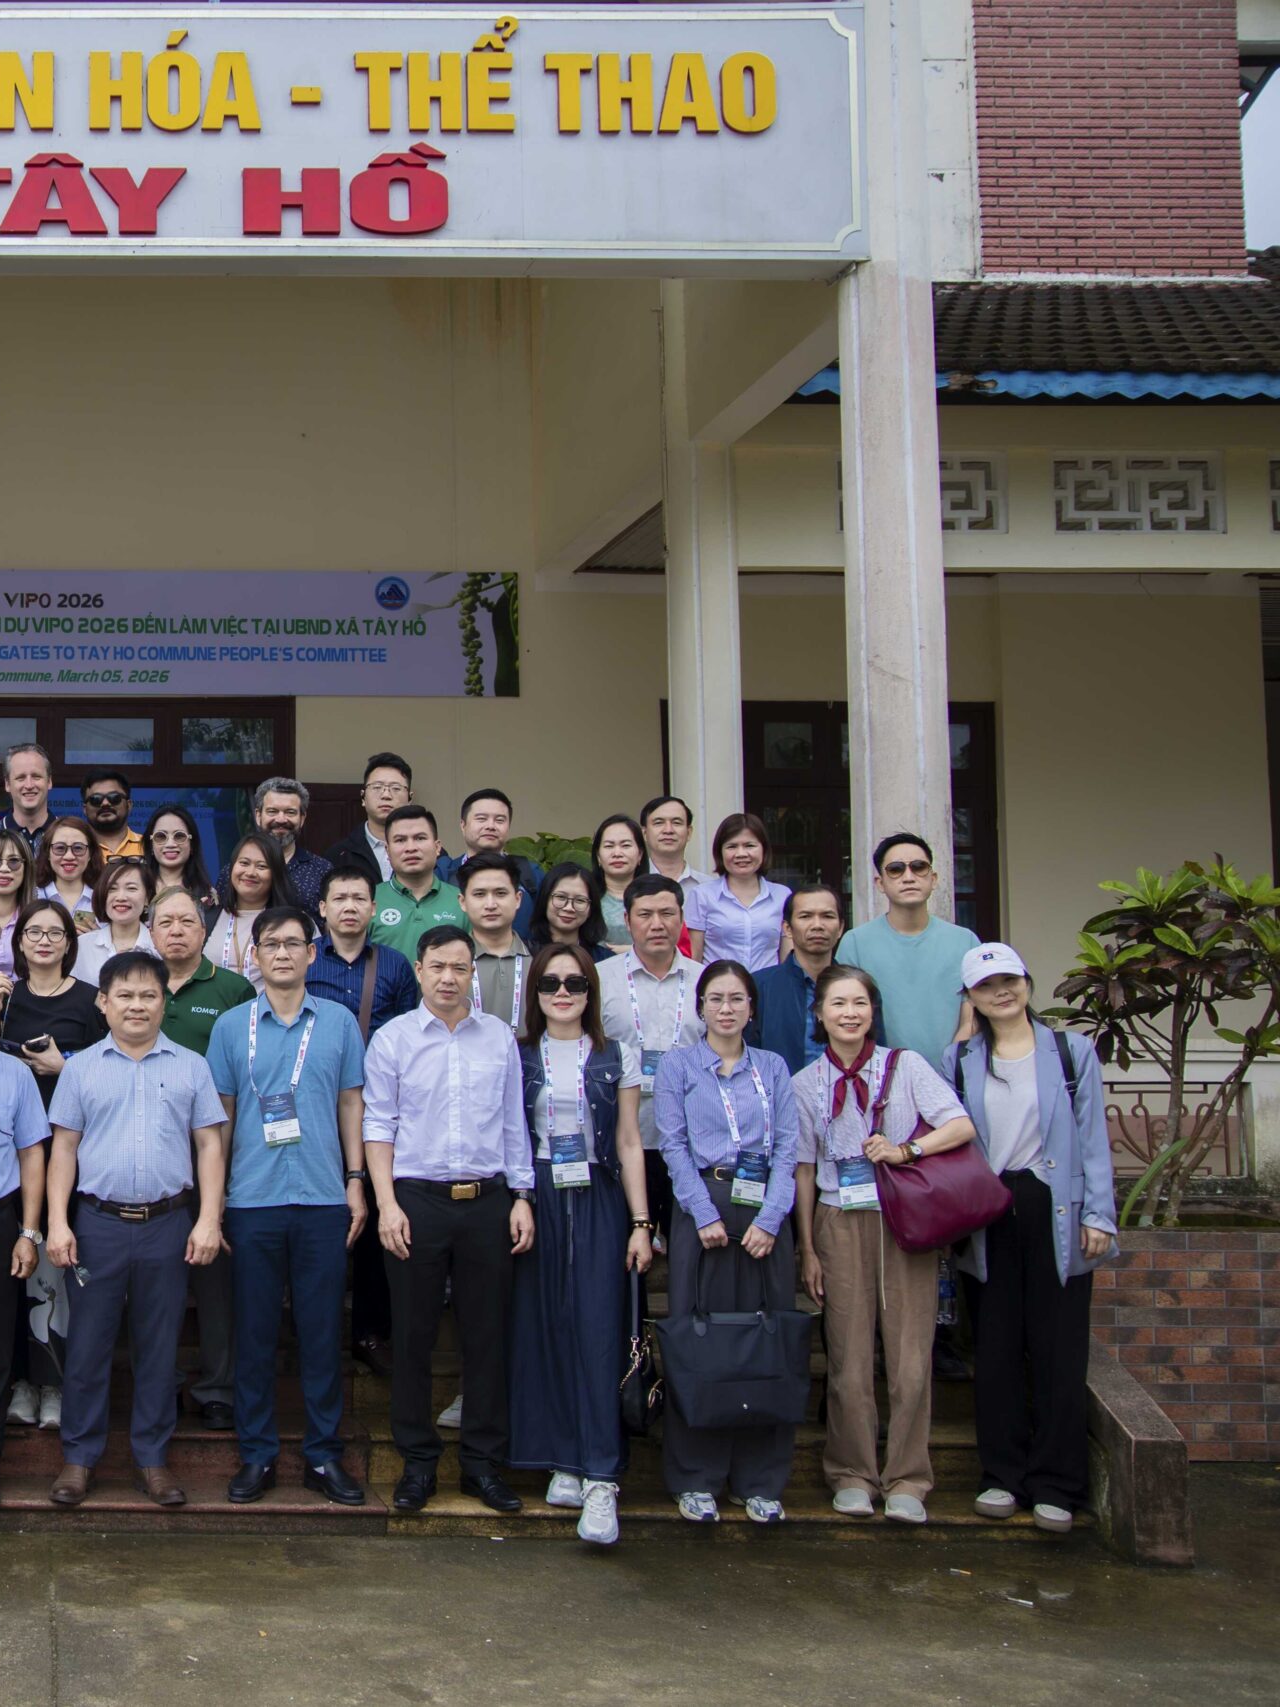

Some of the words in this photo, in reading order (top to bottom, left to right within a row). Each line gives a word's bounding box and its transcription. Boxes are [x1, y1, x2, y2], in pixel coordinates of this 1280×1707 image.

[88, 29, 262, 134] HÓA
[290, 86, 322, 105] -
[354, 15, 520, 134] THỂ
[544, 51, 777, 135] THAO
[241, 140, 449, 237] HỒ
[3, 592, 51, 609] VIPO
[57, 593, 104, 609] 2026
[4, 616, 31, 637] DỰ
[32, 616, 75, 634] VIPO
[77, 617, 129, 634] 2026
[132, 611, 167, 634] ĐẾN
[169, 614, 207, 635] LÀM
[210, 615, 248, 637] VIỆC
[251, 618, 280, 637] TẠI
[283, 618, 332, 636] UBND
[335, 616, 360, 636] XÃ
[363, 616, 399, 636] TÂY
[54, 645, 76, 662] TO
[78, 645, 111, 662] TAY
[113, 645, 136, 662] HO
[138, 645, 217, 662] COMMUNE
[295, 646, 388, 664] COMMITTEE
[57, 670, 99, 684] March
[100, 670, 125, 685] 05,
[128, 670, 170, 684] 2026
